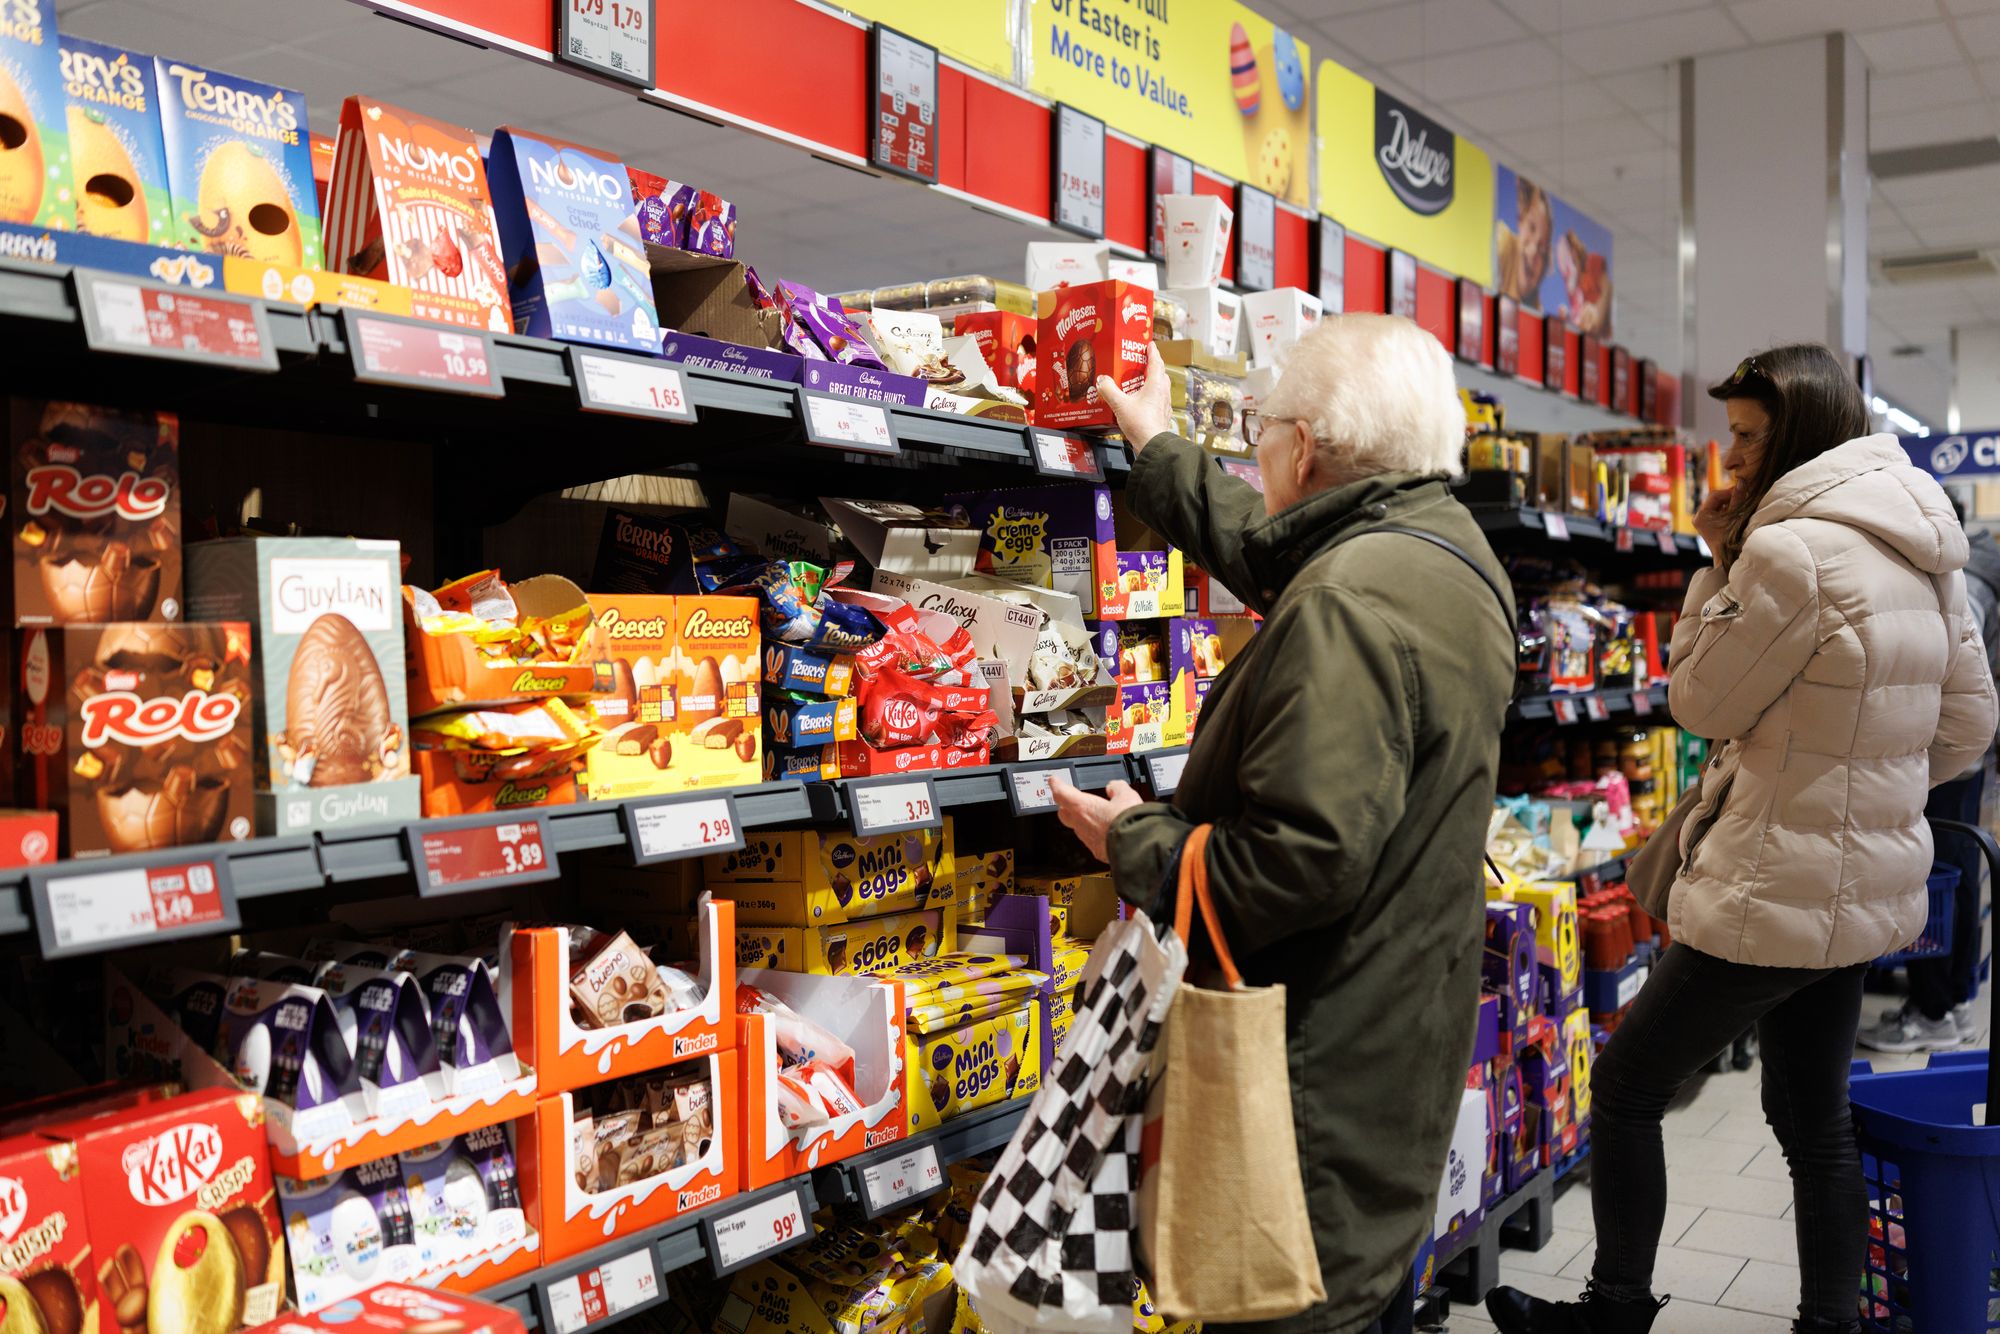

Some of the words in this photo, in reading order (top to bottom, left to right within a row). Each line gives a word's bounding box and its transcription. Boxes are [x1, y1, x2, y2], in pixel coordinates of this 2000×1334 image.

[611, 2, 643, 31] 1.79
[1137, 0, 1168, 24] ull
[1079, 0, 1141, 51] Easter
[1146, 24, 1160, 61] is
[1051, 24, 1105, 78] More
[1111, 56, 1131, 89] to
[1136, 64, 1193, 119] Value.
[67, 80, 147, 113] ORANGE
[232, 117, 299, 146] ORANGE
[378, 132, 475, 183] NOMO
[1380, 108, 1450, 187] Deluxe
[407, 169, 452, 188] MISSING
[457, 183, 479, 195] OUT
[528, 156, 623, 201] NOMO
[1061, 172, 1081, 192] 7.99
[397, 187, 431, 200] Salted
[431, 188, 475, 217] Popcorn
[557, 189, 600, 206] MISSING
[568, 214, 601, 232] Choc
[478, 245, 505, 284] NOMO
[1055, 305, 1096, 340] Maltesers
[1121, 303, 1148, 325] Maltesers
[1074, 319, 1096, 332] Teasers
[722, 346, 749, 364] Cadbury
[1121, 339, 1148, 352] HAPPY
[443, 353, 488, 378] 10.99
[683, 354, 709, 368] GREAT
[713, 359, 728, 372] FOR
[1121, 350, 1148, 365] EASTER
[859, 371, 884, 388] Cadbury
[649, 386, 680, 409] 1.65
[829, 381, 851, 396] GREAT
[853, 385, 867, 399] FOR
[868, 389, 882, 402] EGG
[883, 393, 906, 406] HUNTS
[930, 396, 957, 412] Galaxy
[1973, 434, 2000, 468] C
[26, 464, 169, 521] Rolo
[1005, 507, 1034, 519] Cadbury
[1100, 497, 1106, 510] 5
[996, 524, 1041, 541] creme
[1005, 536, 1034, 554] egg
[1055, 550, 1067, 558] 200
[1068, 551, 1073, 559] g
[1064, 540, 1083, 548] PACK
[635, 547, 671, 566] ORANGE
[879, 575, 889, 584] 22
[896, 579, 905, 588] 74
[919, 594, 978, 628] Galaxy
[1007, 610, 1036, 626] CT44V
[1102, 604, 1125, 615] classic
[1134, 600, 1153, 612] White
[1161, 602, 1183, 611] Caramel
[598, 608, 667, 639] Reese's
[683, 608, 752, 639] Reese's
[1106, 633, 1113, 646] 5
[512, 671, 567, 691] Reese's
[981, 667, 1001, 677] T44V
[1033, 693, 1057, 709] Galaxy
[80, 689, 241, 748] Rolo
[884, 701, 918, 728] KitKat
[22, 723, 62, 755] Rolo
[1028, 739, 1051, 754] Galaxy
[1106, 738, 1129, 750] classic
[1138, 730, 1157, 746] White
[1164, 731, 1185, 742] Caramel
[494, 783, 550, 805] Reese's
[906, 799, 930, 821] 3.79
[700, 819, 731, 844] 2.99
[501, 843, 542, 874] 3.89
[738, 855, 762, 868] eggs
[858, 839, 902, 879] Mini
[858, 865, 908, 900] eggs
[940, 882, 953, 894] Mini
[940, 890, 953, 901] eggs
[154, 896, 193, 922] 3.49
[740, 938, 761, 953] Mini
[741, 949, 764, 964] eggs
[437, 971, 467, 984] STAR
[589, 952, 623, 993] bueno
[363, 985, 394, 999] STAR
[432, 982, 465, 997] WARS
[278, 1004, 308, 1018] STAR
[358, 996, 393, 1013] WARS
[274, 1015, 309, 1031] WARS
[673, 1033, 718, 1058] Kinder
[955, 1033, 994, 1078] Mini
[955, 1059, 999, 1099] eggs
[1026, 1072, 1037, 1083] Mini
[1026, 1079, 1038, 1090] eggs
[464, 1133, 506, 1152] WARS
[466, 1124, 501, 1141] STAR
[865, 1125, 899, 1149] Kinder
[131, 1123, 221, 1206] KitKat
[360, 1154, 398, 1172] STAR
[926, 1166, 938, 1178] 1.69
[1450, 1155, 1465, 1181] Mini
[197, 1156, 256, 1210] CRISPY
[356, 1165, 398, 1186] WARS
[1450, 1171, 1467, 1197] eggs
[678, 1184, 721, 1212] Kinder
[716, 1225, 731, 1237] Mini
[731, 1219, 747, 1232] Eggs
[0, 1212, 68, 1270] CRISPY
[760, 1291, 791, 1312] Mini
[756, 1304, 791, 1326] eggs
